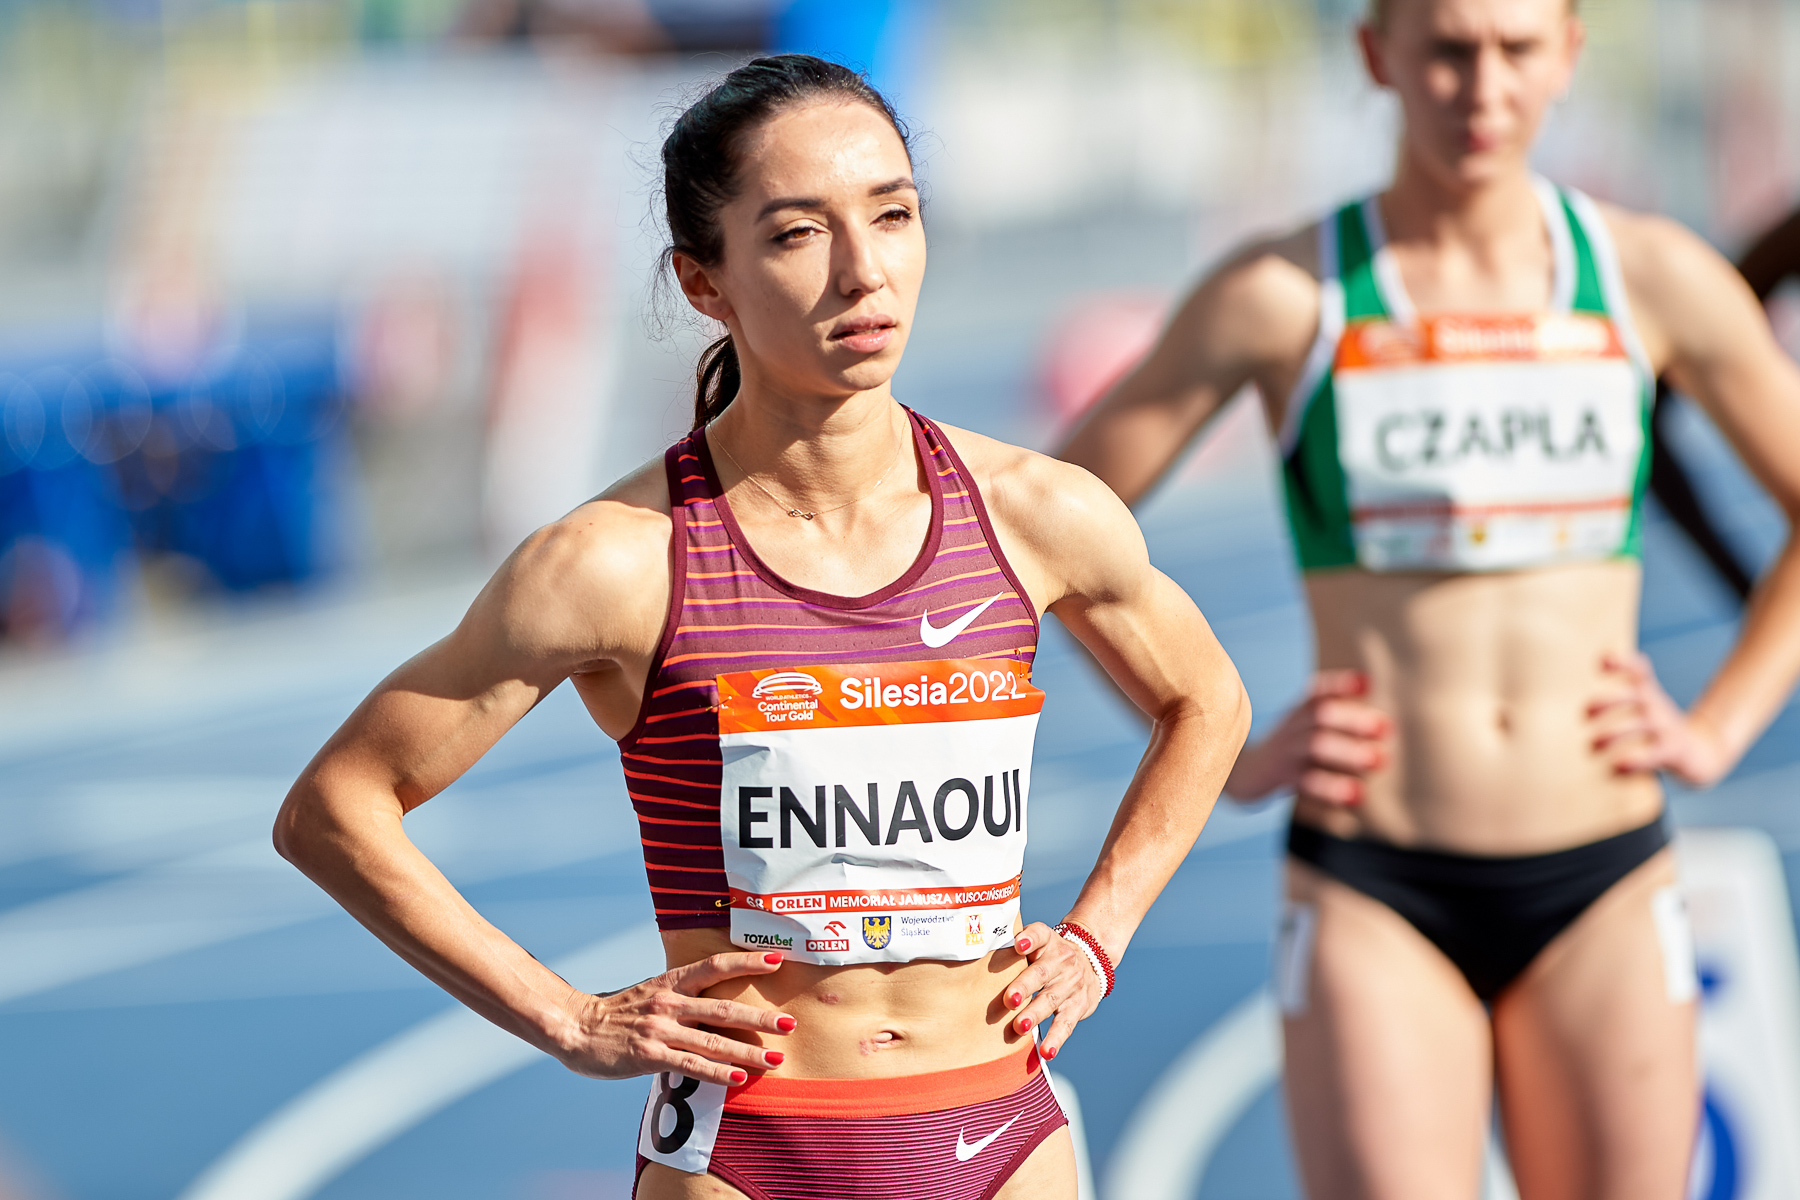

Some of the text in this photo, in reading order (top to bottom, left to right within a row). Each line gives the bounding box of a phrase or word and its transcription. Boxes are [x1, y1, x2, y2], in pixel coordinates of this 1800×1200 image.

[1376, 406, 1609, 471] CZAPLA
[839, 669, 1027, 709] Silesia2022
[757, 698, 819, 712] Continental
[763, 709, 814, 722] Tour Gold
[738, 768, 1021, 849] ENNAOUI
[775, 897, 823, 909] ORLEN
[829, 894, 897, 908] MEMORIAŁ
[898, 892, 953, 906] JANUSZA
[955, 883, 1015, 904] KUSOCIŃSKIEGO
[900, 915, 955, 926] Województwo
[900, 928, 931, 937] Śląskie
[744, 933, 793, 947] TOTALbet
[808, 941, 848, 951] ORLEN
[651, 1071, 701, 1155] 8
